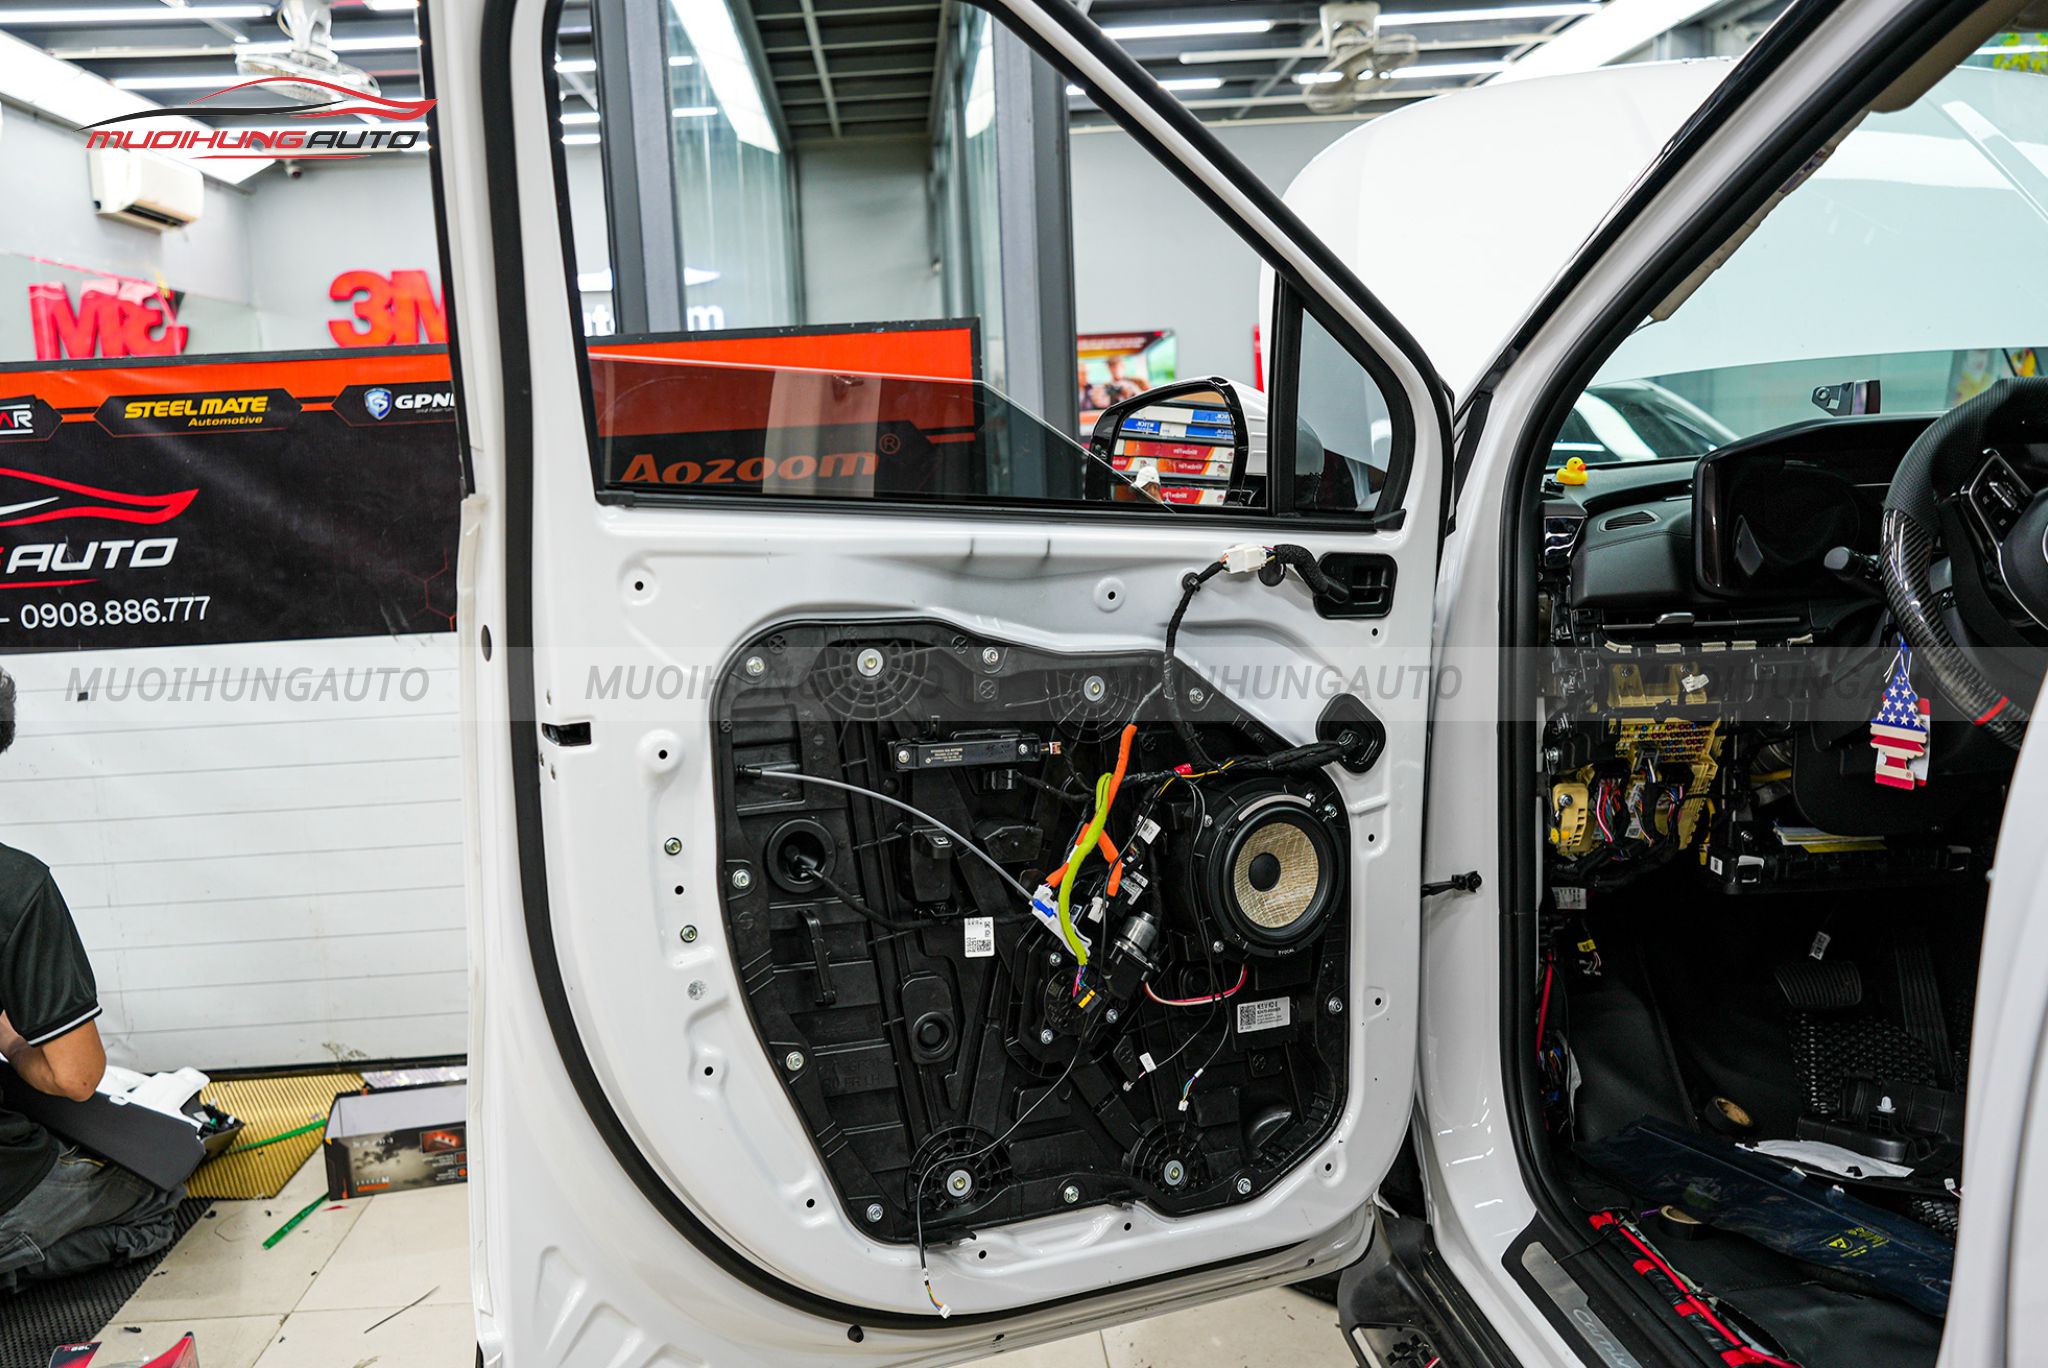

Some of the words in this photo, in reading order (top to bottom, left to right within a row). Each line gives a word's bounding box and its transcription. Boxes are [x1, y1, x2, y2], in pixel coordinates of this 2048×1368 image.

[188, 415, 263, 427] Automotive
[0, 537, 179, 574] AUTO
[20, 595, 211, 630] 0908.886.777
